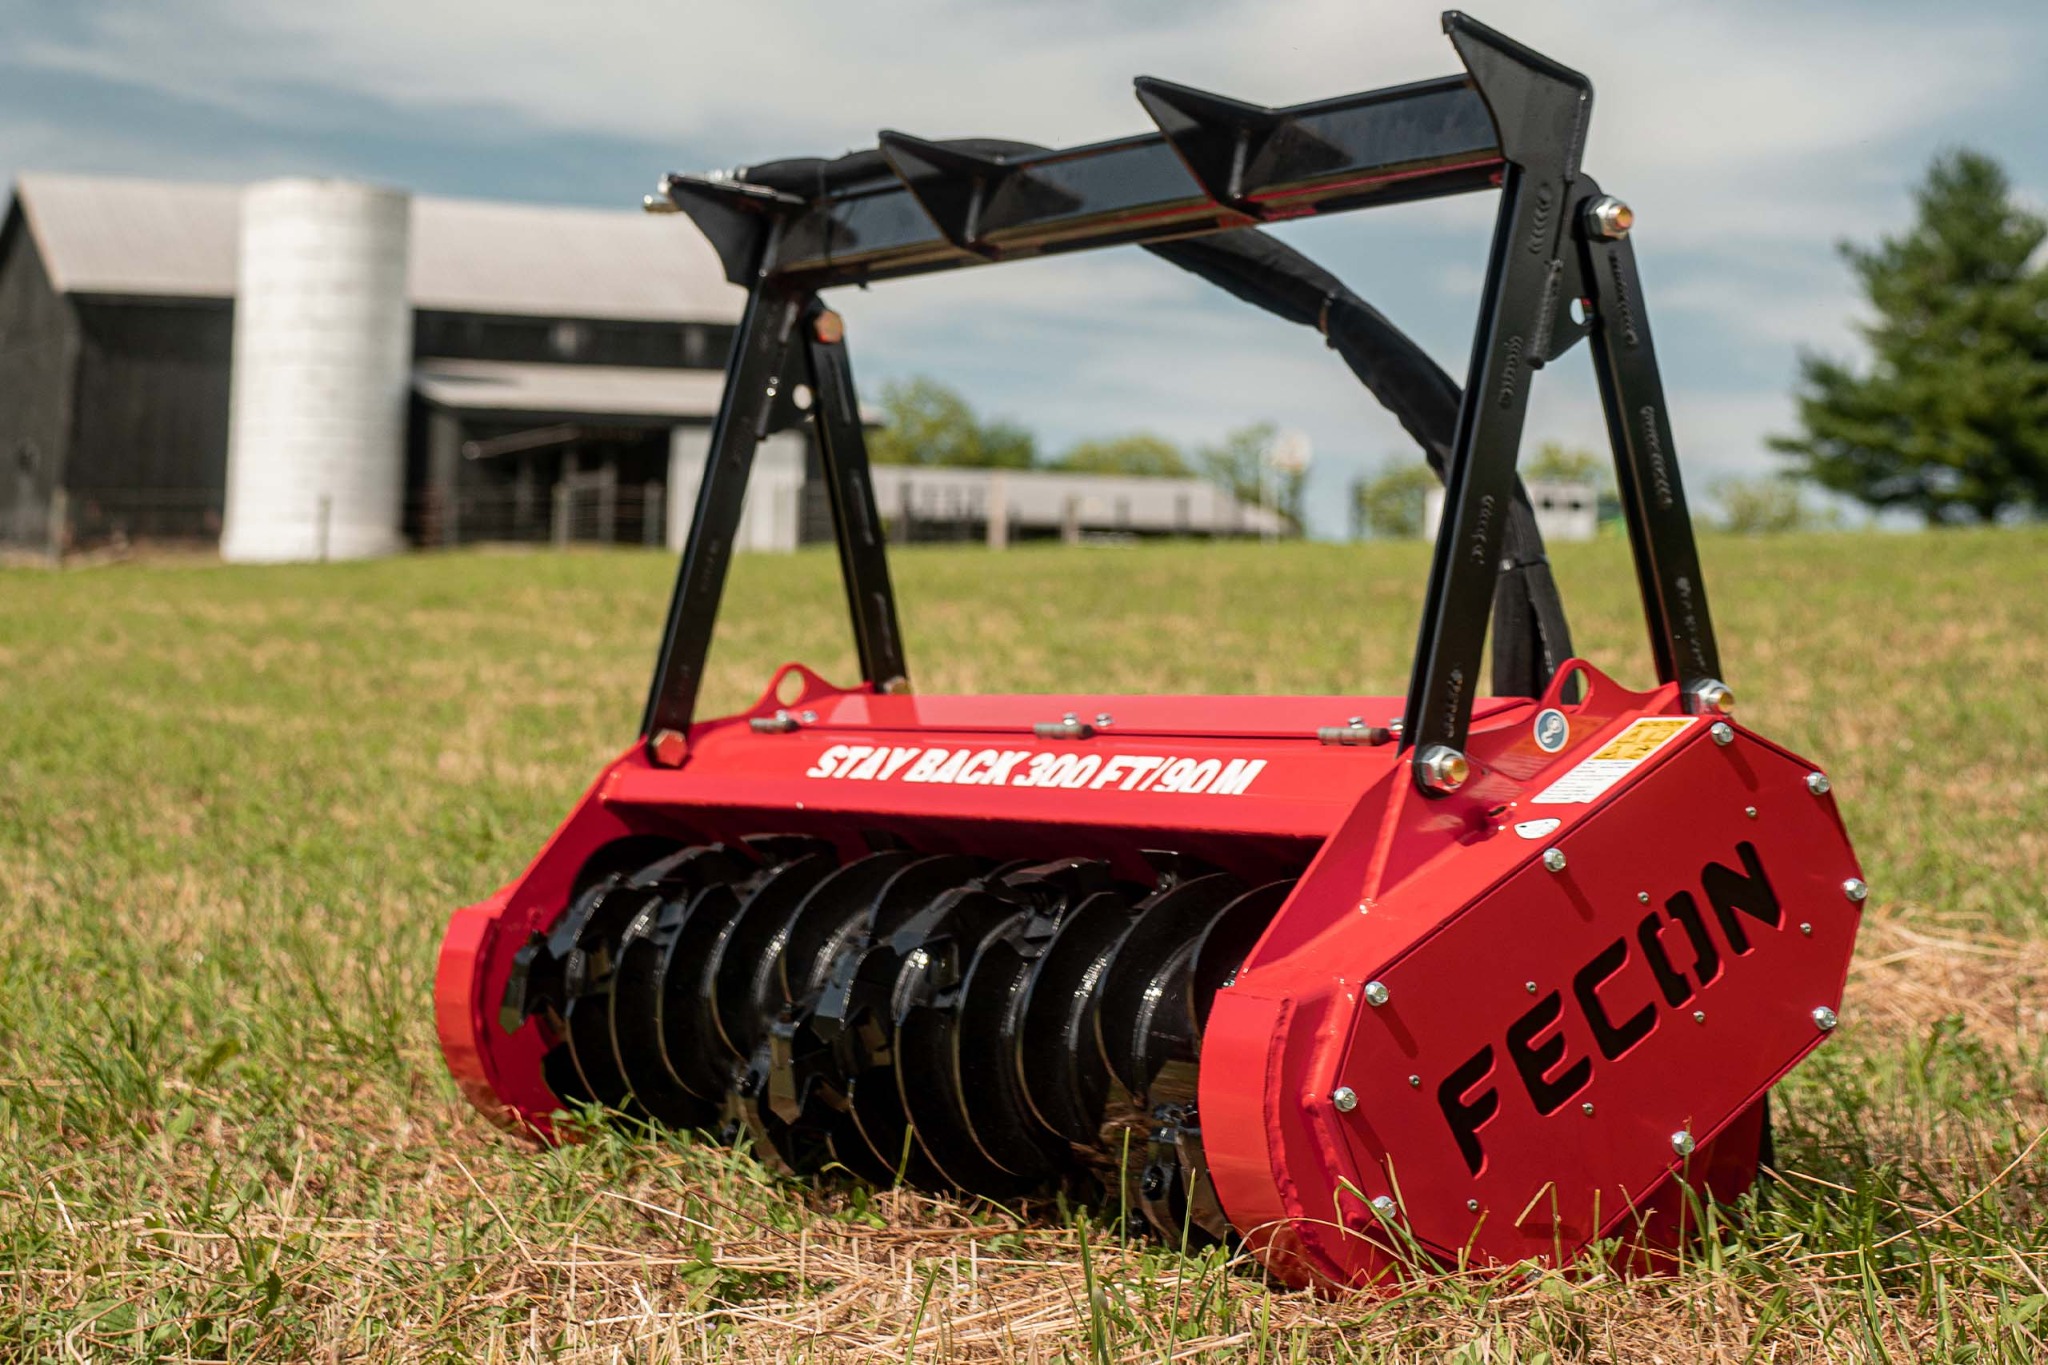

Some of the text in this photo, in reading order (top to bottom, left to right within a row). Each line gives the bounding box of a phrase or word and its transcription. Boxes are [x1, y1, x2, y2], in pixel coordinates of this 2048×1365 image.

[806, 745, 921, 780] STAY
[902, 748, 1031, 785] BACK
[1011, 752, 1102, 788] 300
[1437, 840, 1784, 1179] FECON
